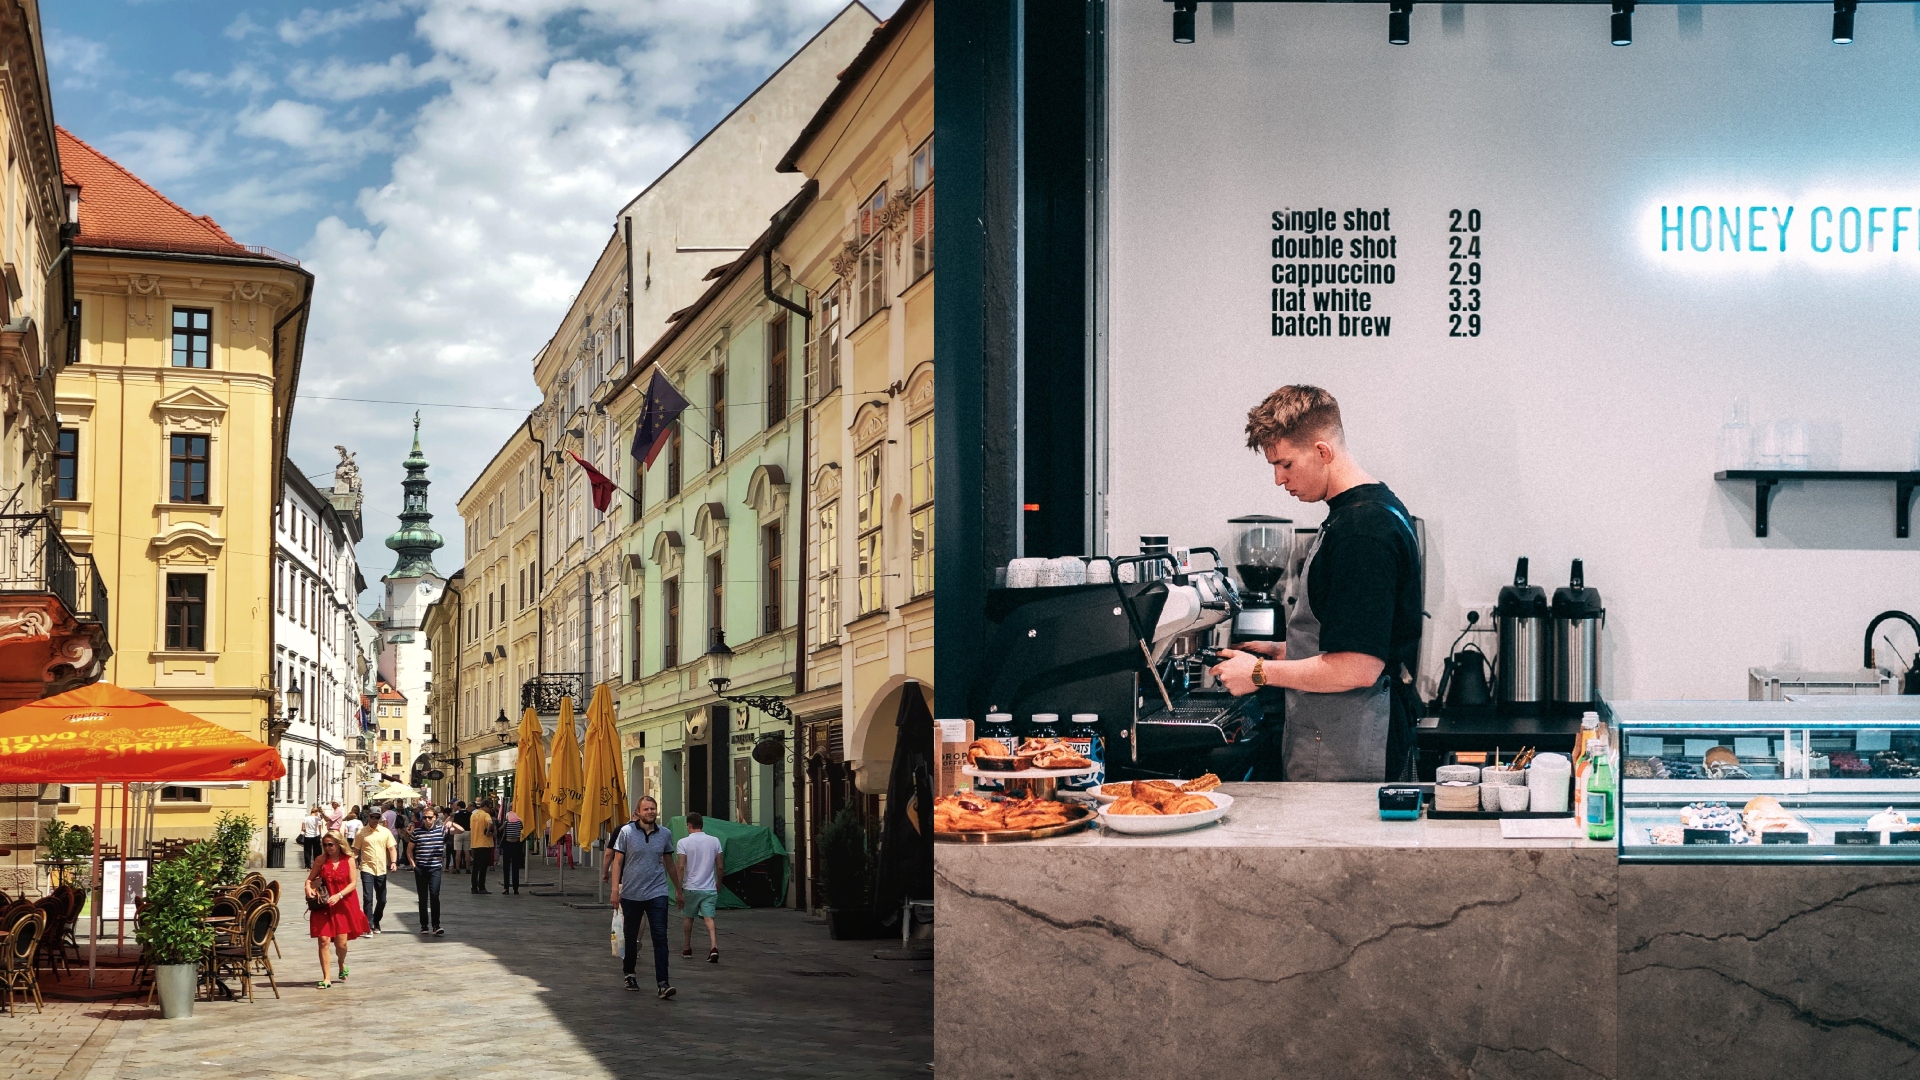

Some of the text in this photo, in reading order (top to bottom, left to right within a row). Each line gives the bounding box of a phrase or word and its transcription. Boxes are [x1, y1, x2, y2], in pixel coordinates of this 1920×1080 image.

[1271, 207, 1482, 234] single shot 2.0
[1661, 205, 1920, 253] HONEY COFF
[1271, 235, 1482, 259] double shot 2.4
[1271, 260, 1482, 288] cappuccino 2.9
[1271, 288, 1482, 312] flat white 3.3
[1271, 313, 1482, 338] batch brew 2.9
[62, 712, 114, 721] APEROL
[70, 715, 105, 724] SPRITZ
[104, 740, 194, 760] SPRITZ
